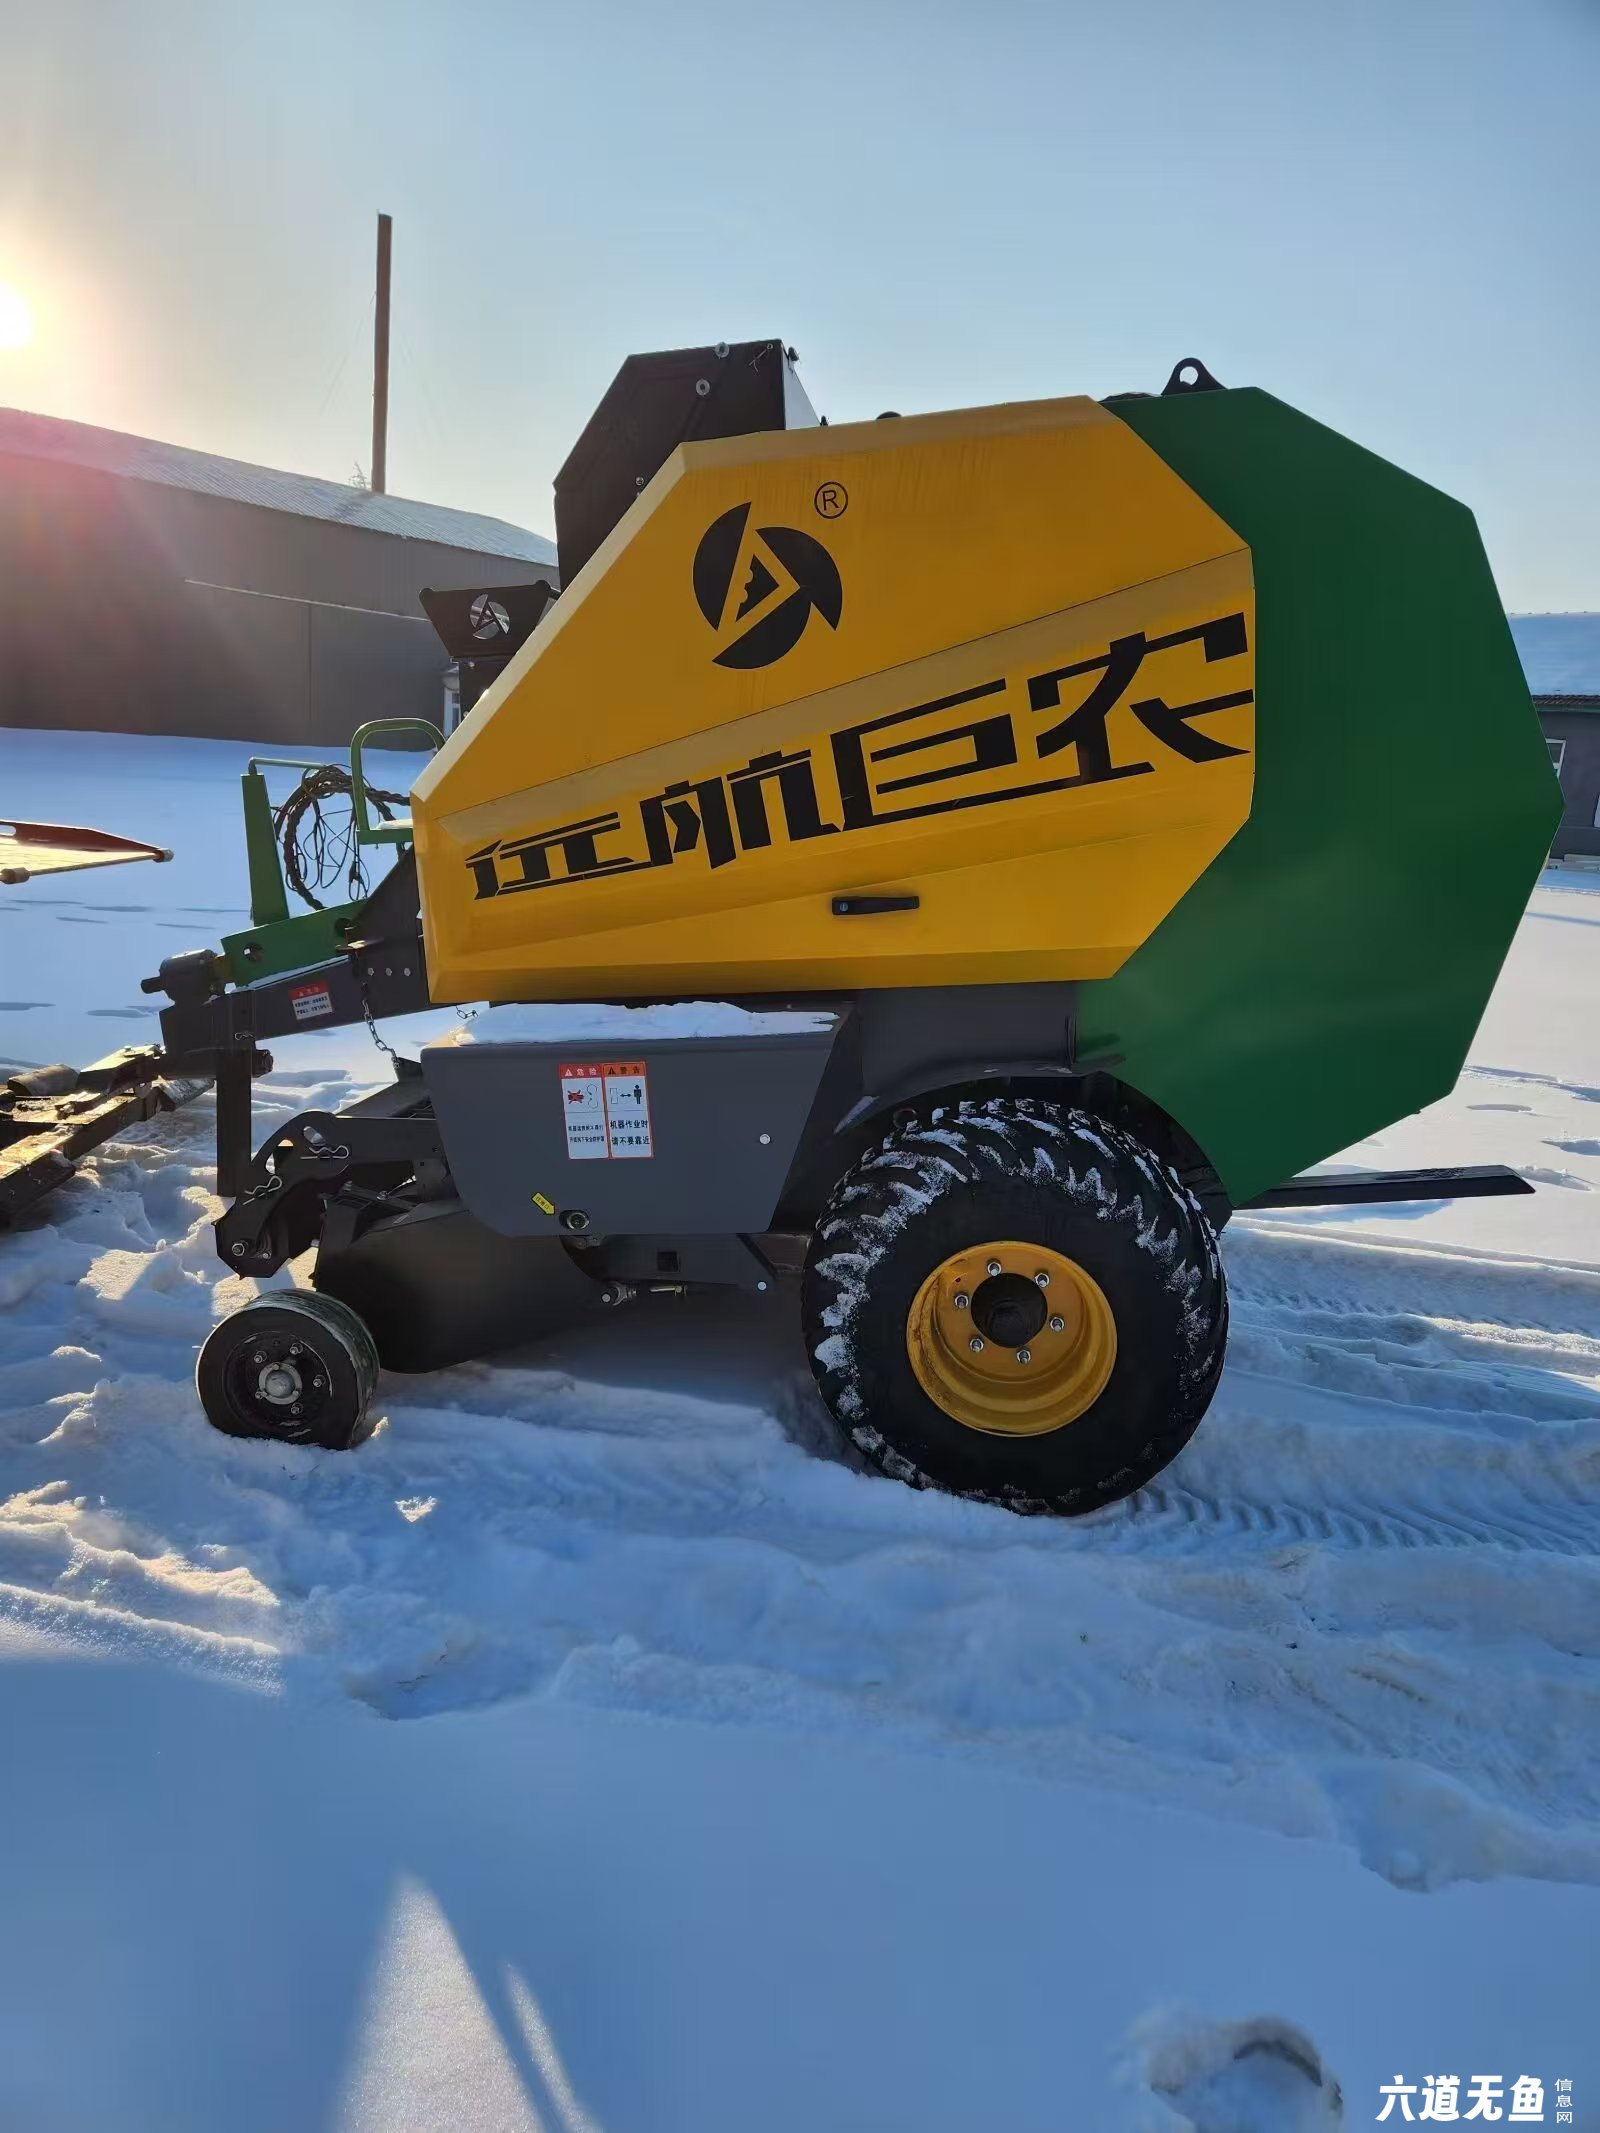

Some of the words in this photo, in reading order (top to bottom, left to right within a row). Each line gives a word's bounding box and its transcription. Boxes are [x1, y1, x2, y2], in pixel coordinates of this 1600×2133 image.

[464, 612, 1255, 901] 远航巨农
[610, 1119, 649, 1130] 机器作业时
[611, 1135, 651, 1146] 请不要靠近
